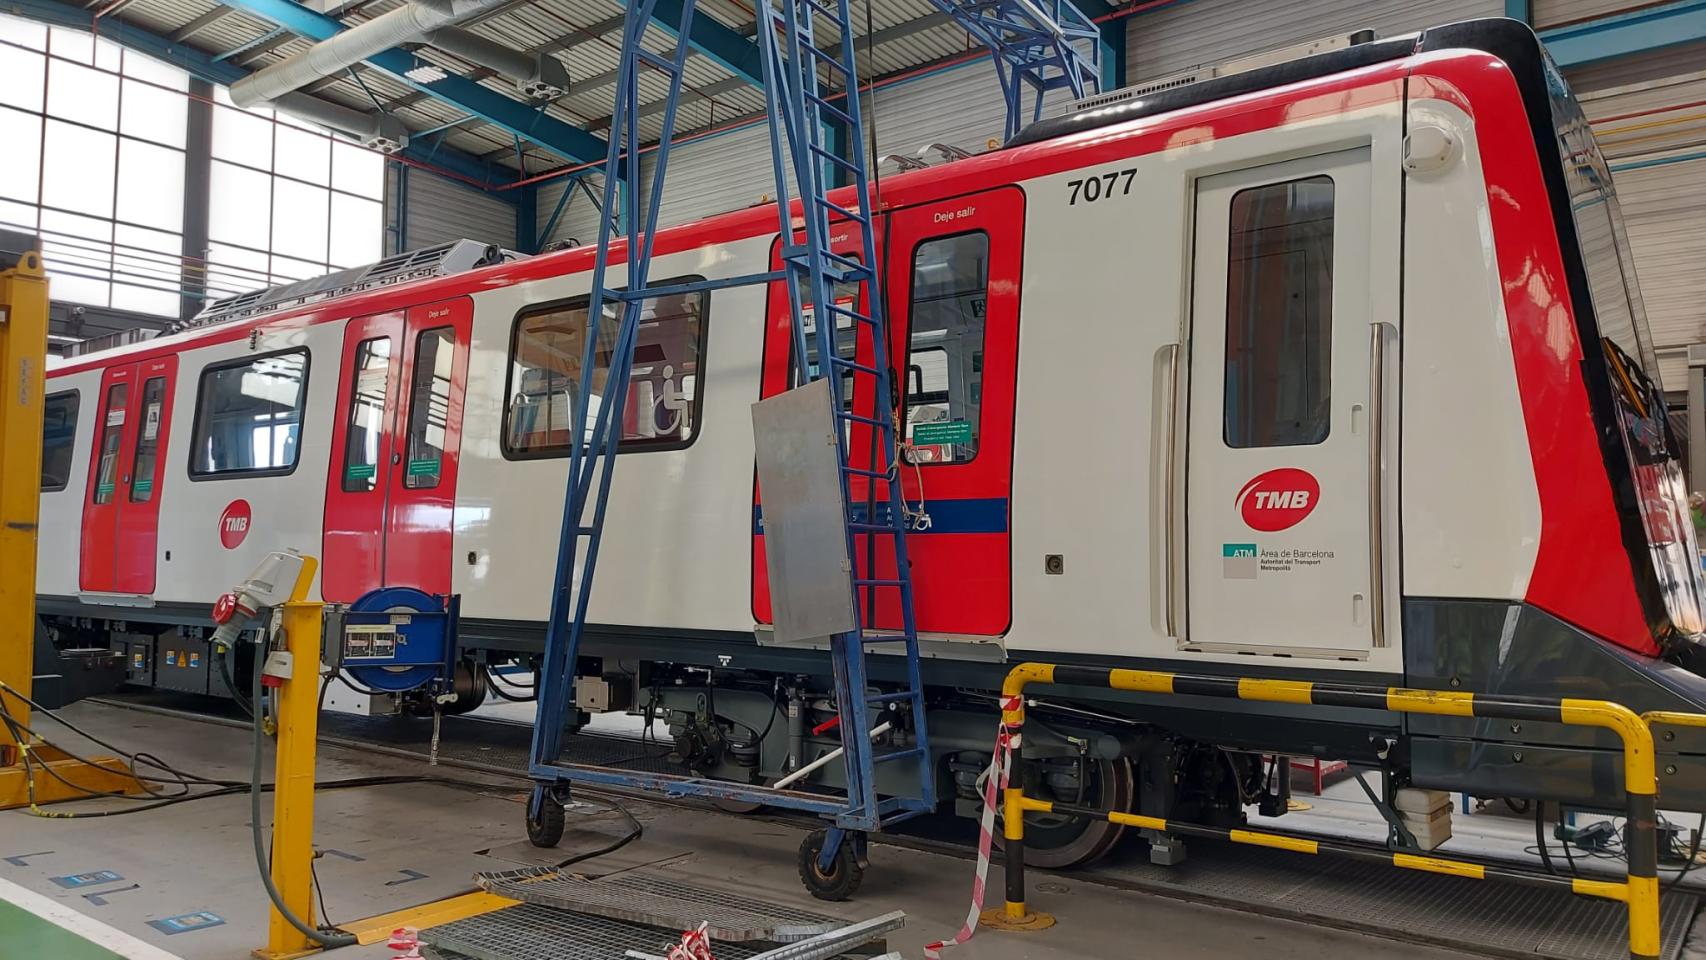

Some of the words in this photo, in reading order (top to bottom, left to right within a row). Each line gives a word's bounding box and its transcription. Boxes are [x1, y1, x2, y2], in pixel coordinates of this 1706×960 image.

[1067, 168, 1138, 206] 7077
[934, 211, 955, 223] Deje
[957, 206, 977, 219] salir
[830, 233, 849, 243] sortir
[1255, 490, 1310, 510] TMB
[225, 517, 248, 532] TMB
[1233, 549, 1254, 558] ATM
[1280, 549, 1291, 558] de
[1293, 549, 1335, 559] Barcelona
[1294, 559, 1321, 567] Transport
